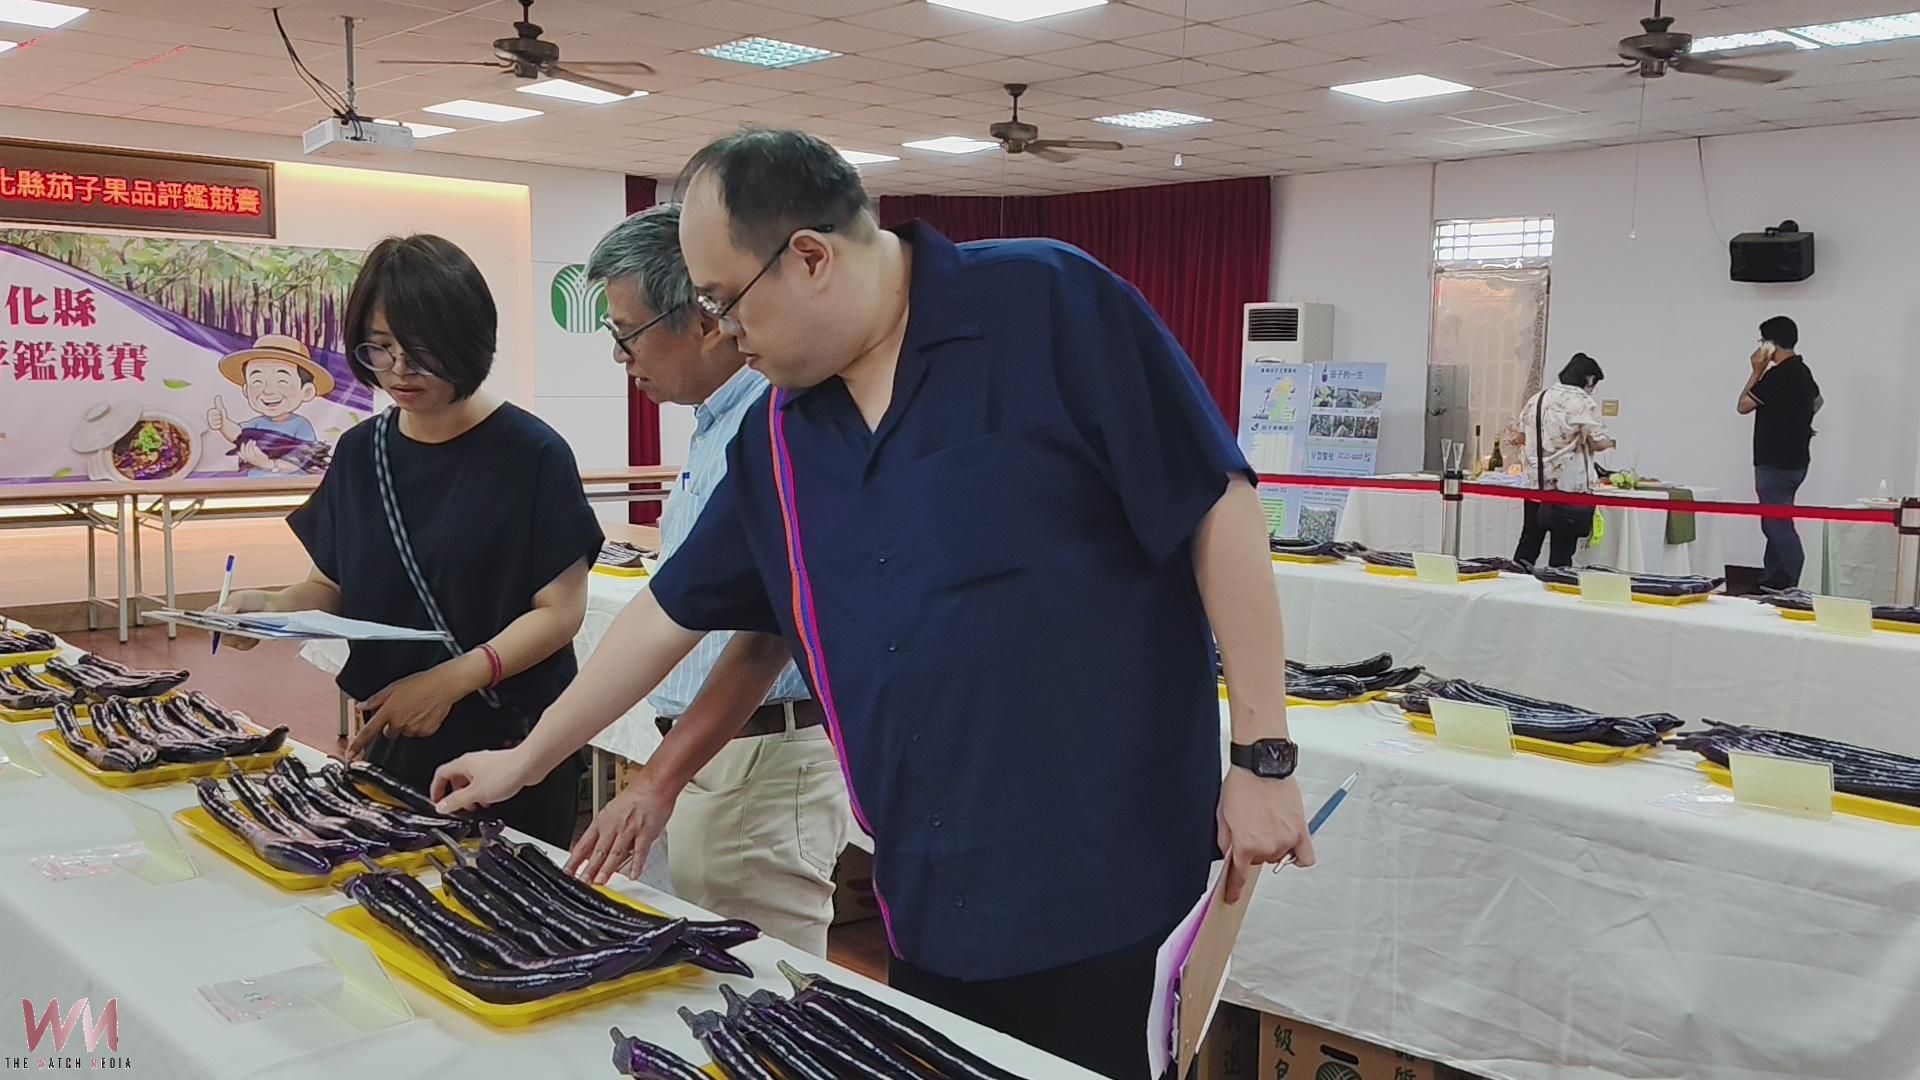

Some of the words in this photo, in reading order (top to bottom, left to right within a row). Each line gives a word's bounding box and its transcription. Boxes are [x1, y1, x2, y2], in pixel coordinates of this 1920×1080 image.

[5, 285, 97, 328] 化縣
[0, 340, 149, 382] 鑑競賽
